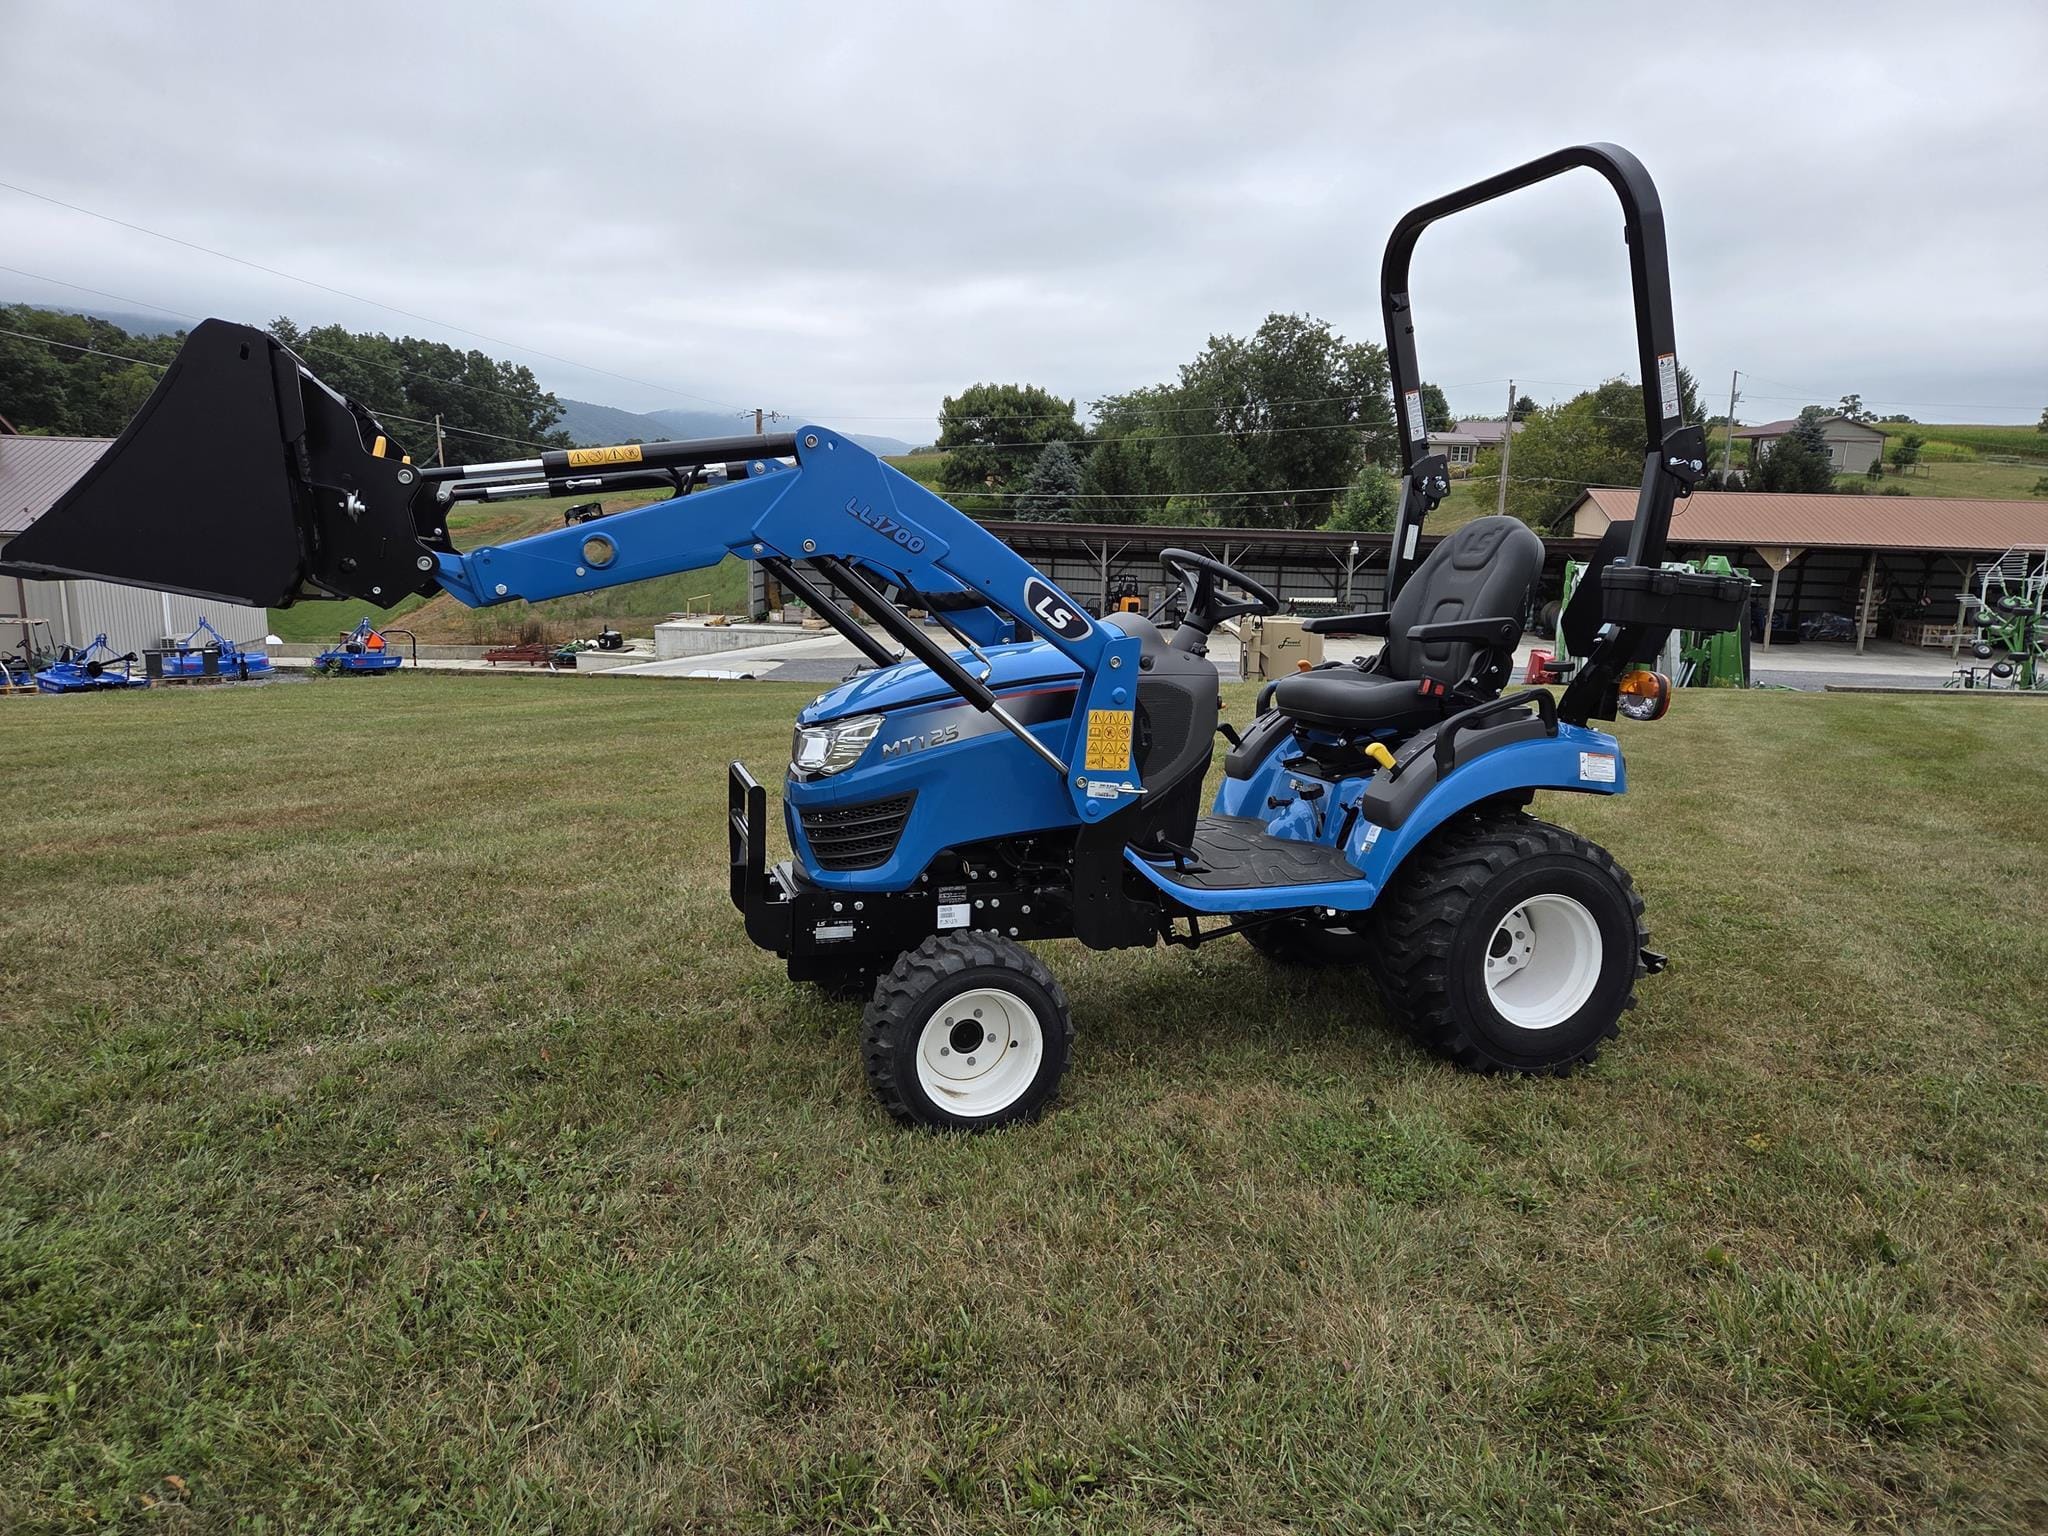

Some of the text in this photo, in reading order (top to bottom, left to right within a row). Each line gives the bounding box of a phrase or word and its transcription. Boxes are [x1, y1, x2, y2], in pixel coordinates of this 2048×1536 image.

[845, 496, 926, 554] LL1700
[1035, 596, 1073, 629] LS
[882, 723, 959, 760] MT125
